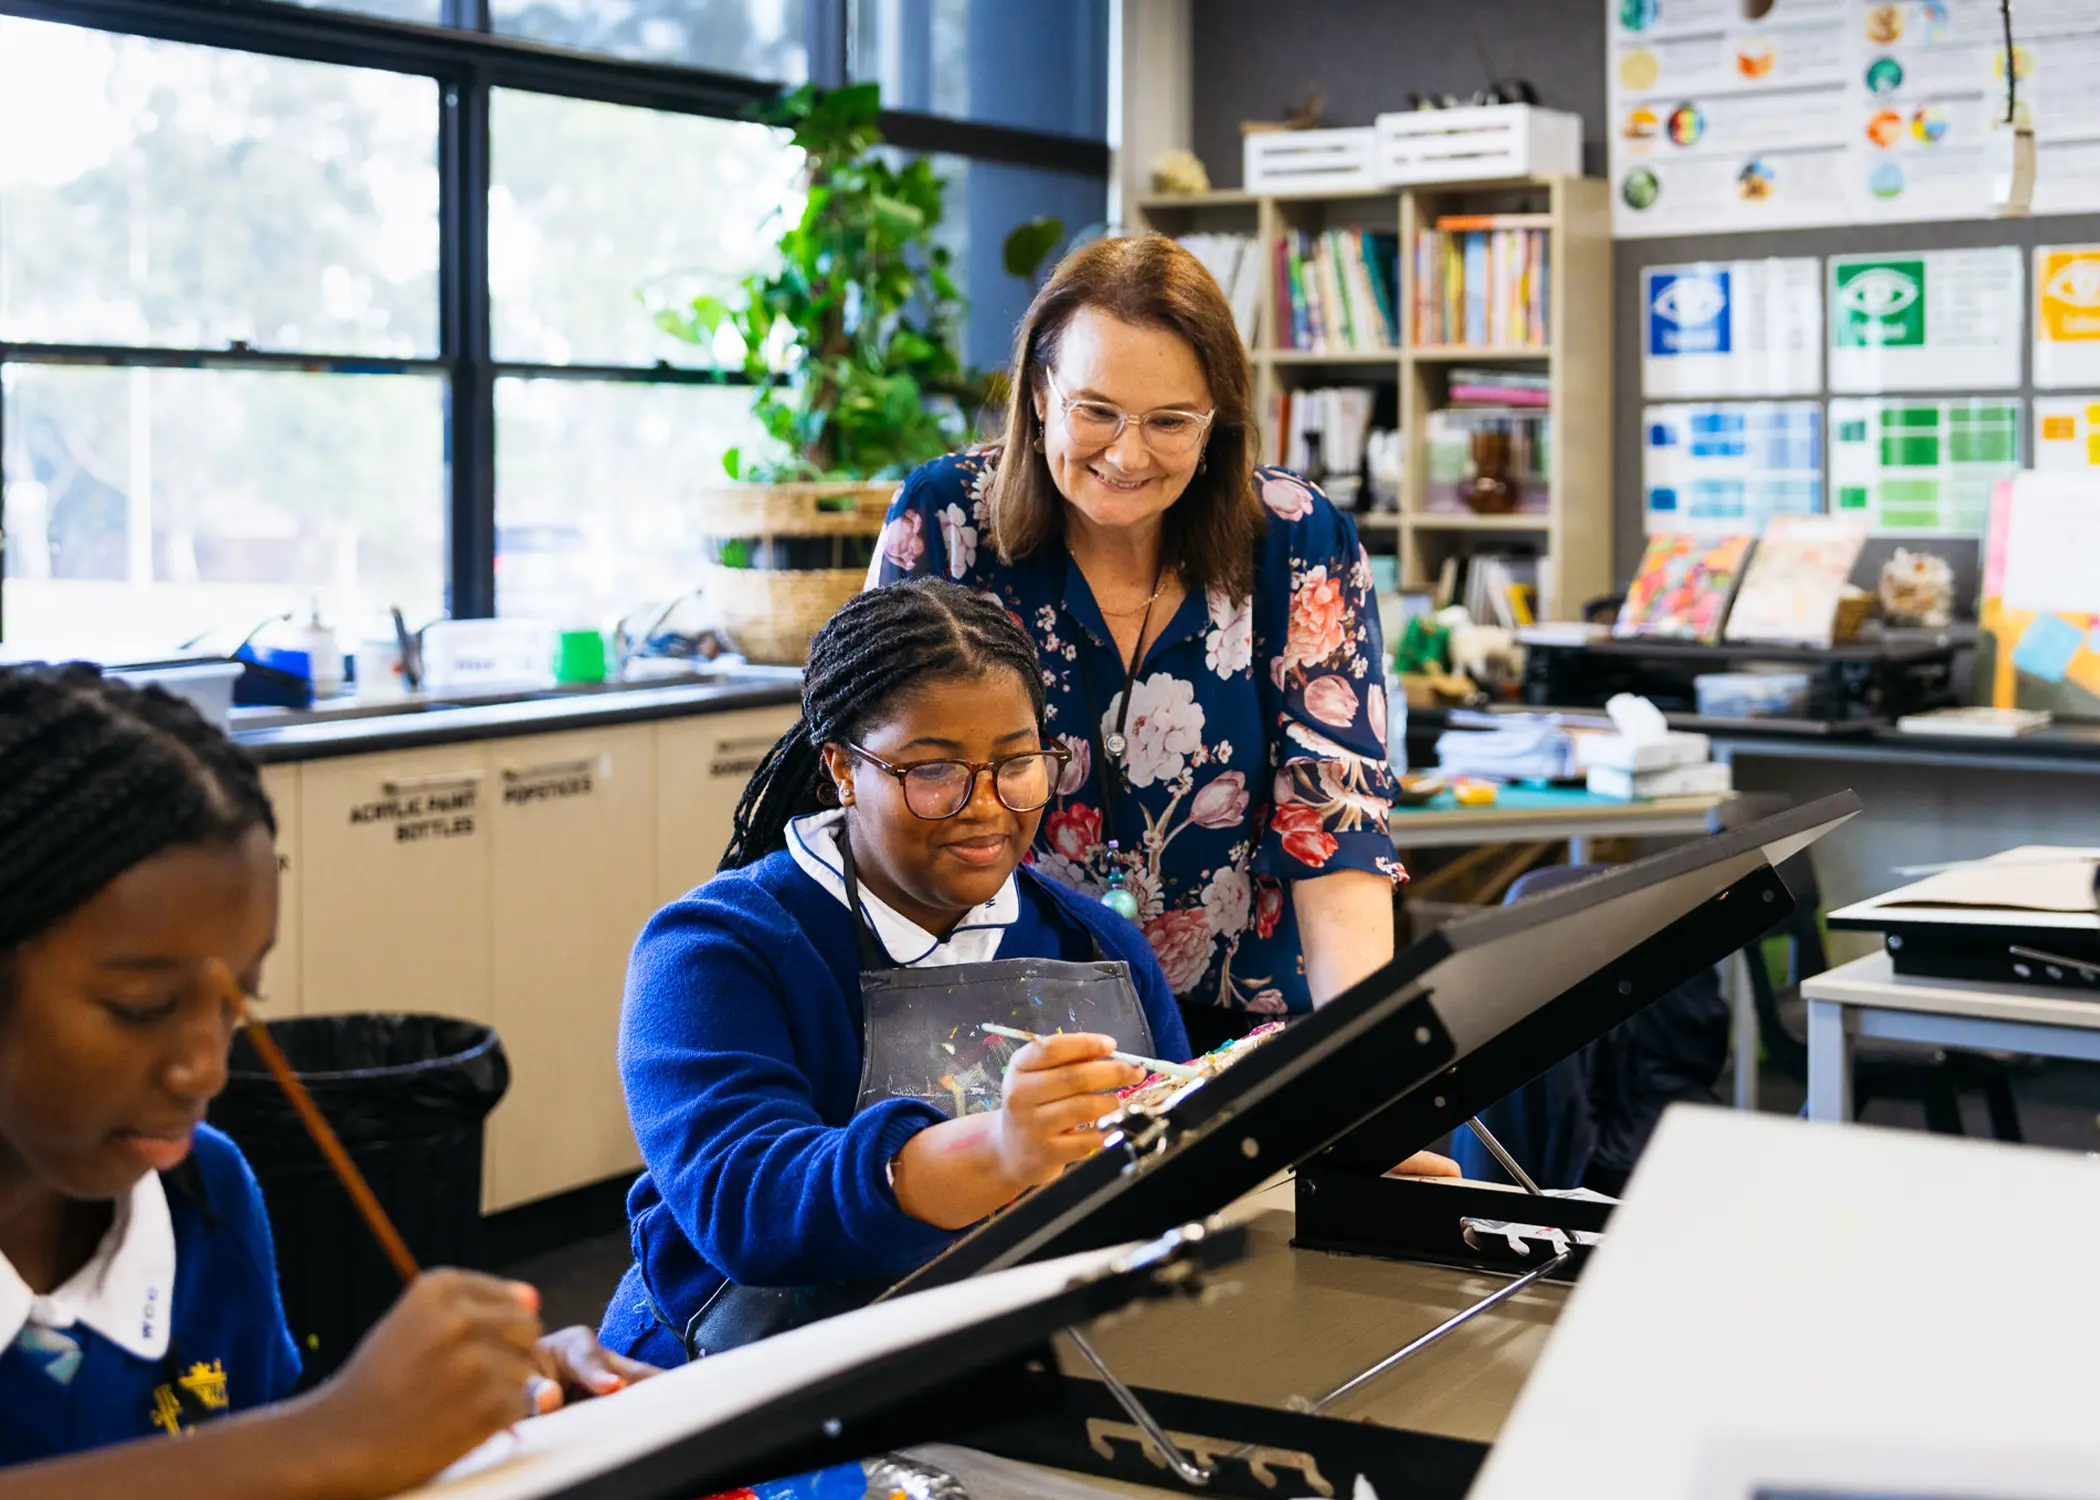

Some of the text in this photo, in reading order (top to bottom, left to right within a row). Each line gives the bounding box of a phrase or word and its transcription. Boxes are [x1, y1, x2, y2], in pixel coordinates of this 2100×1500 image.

[349, 789, 475, 823] ACRYLIC PAINT
[396, 815, 474, 842] BOTTLES
